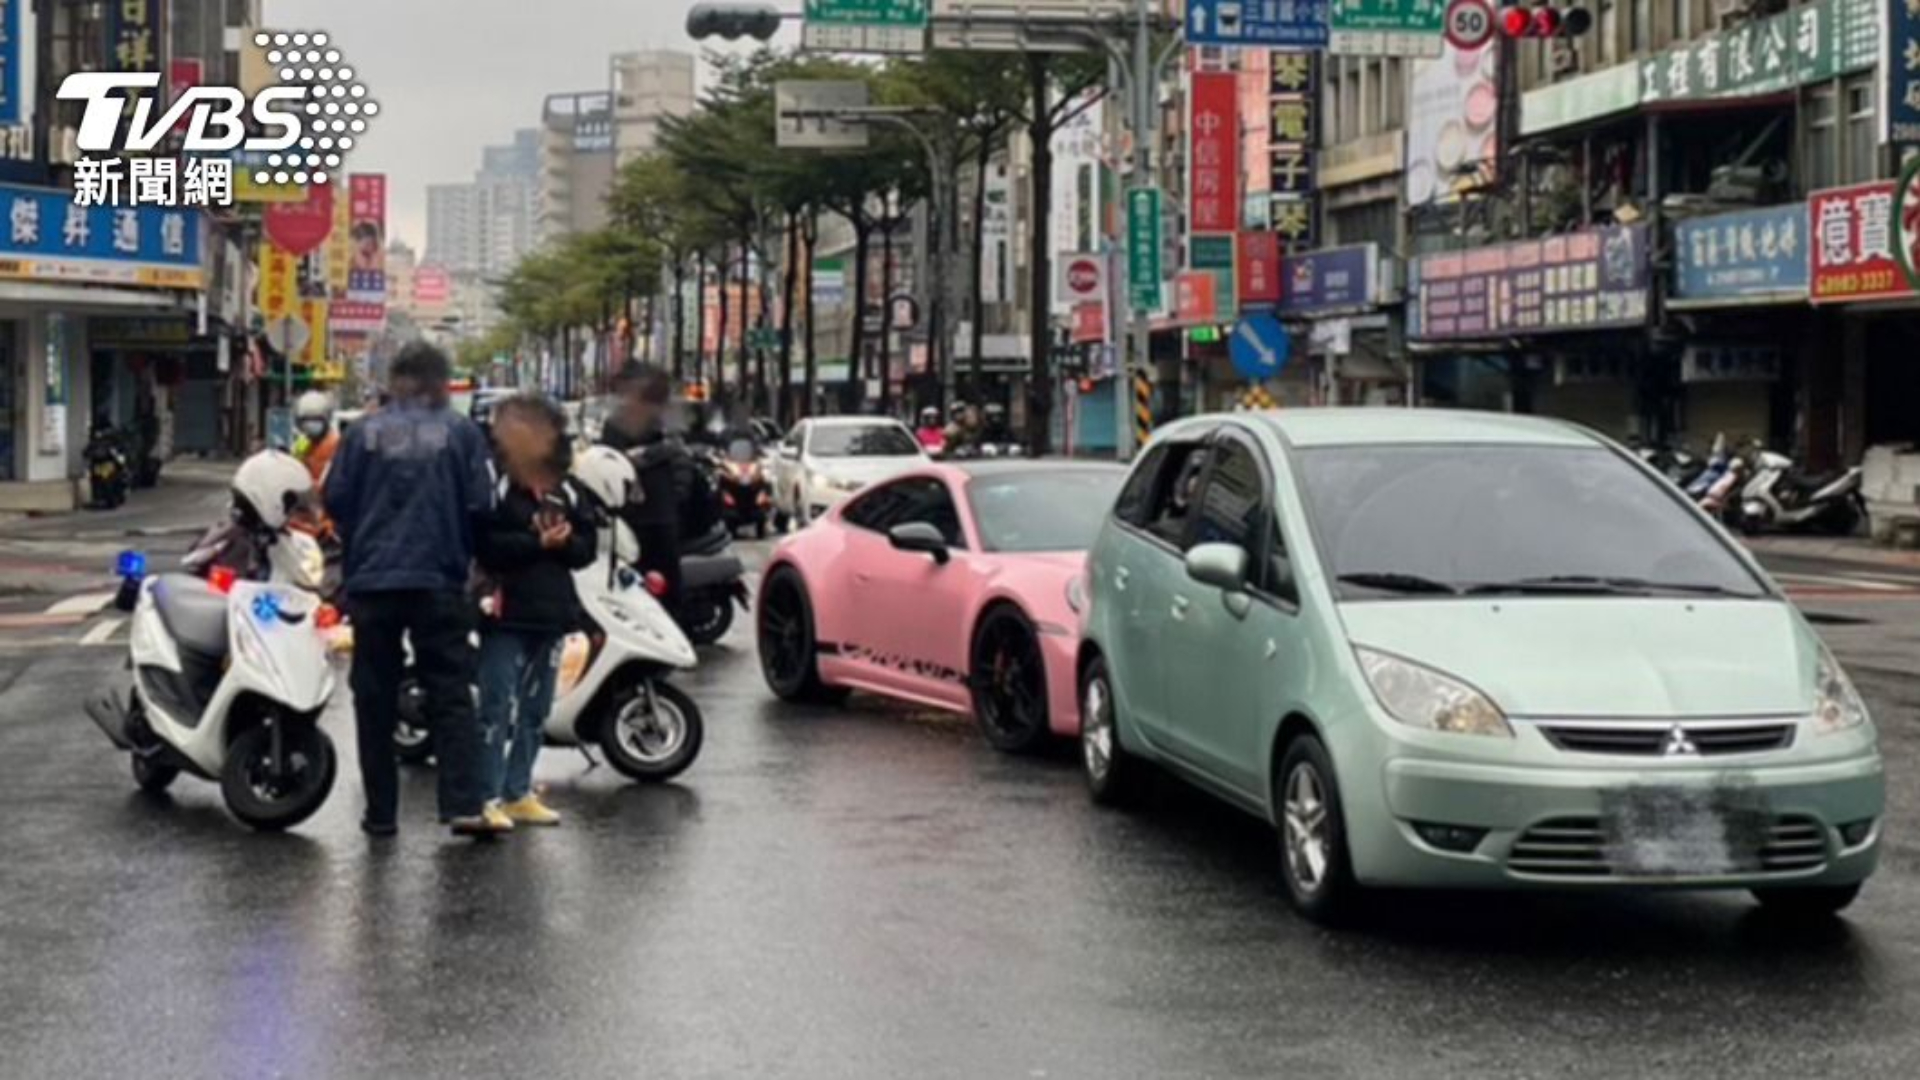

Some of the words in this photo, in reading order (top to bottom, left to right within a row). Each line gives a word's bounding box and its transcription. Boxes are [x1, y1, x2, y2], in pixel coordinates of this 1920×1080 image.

[1455, 11, 1481, 33] 50
[1642, 8, 1820, 101] 工程有限公司
[1194, 109, 1220, 225] 中信房屋
[1272, 53, 1309, 243] 琴電子琴
[10, 197, 185, 255] 傑昇通信
[1815, 192, 1894, 267] 億寶
